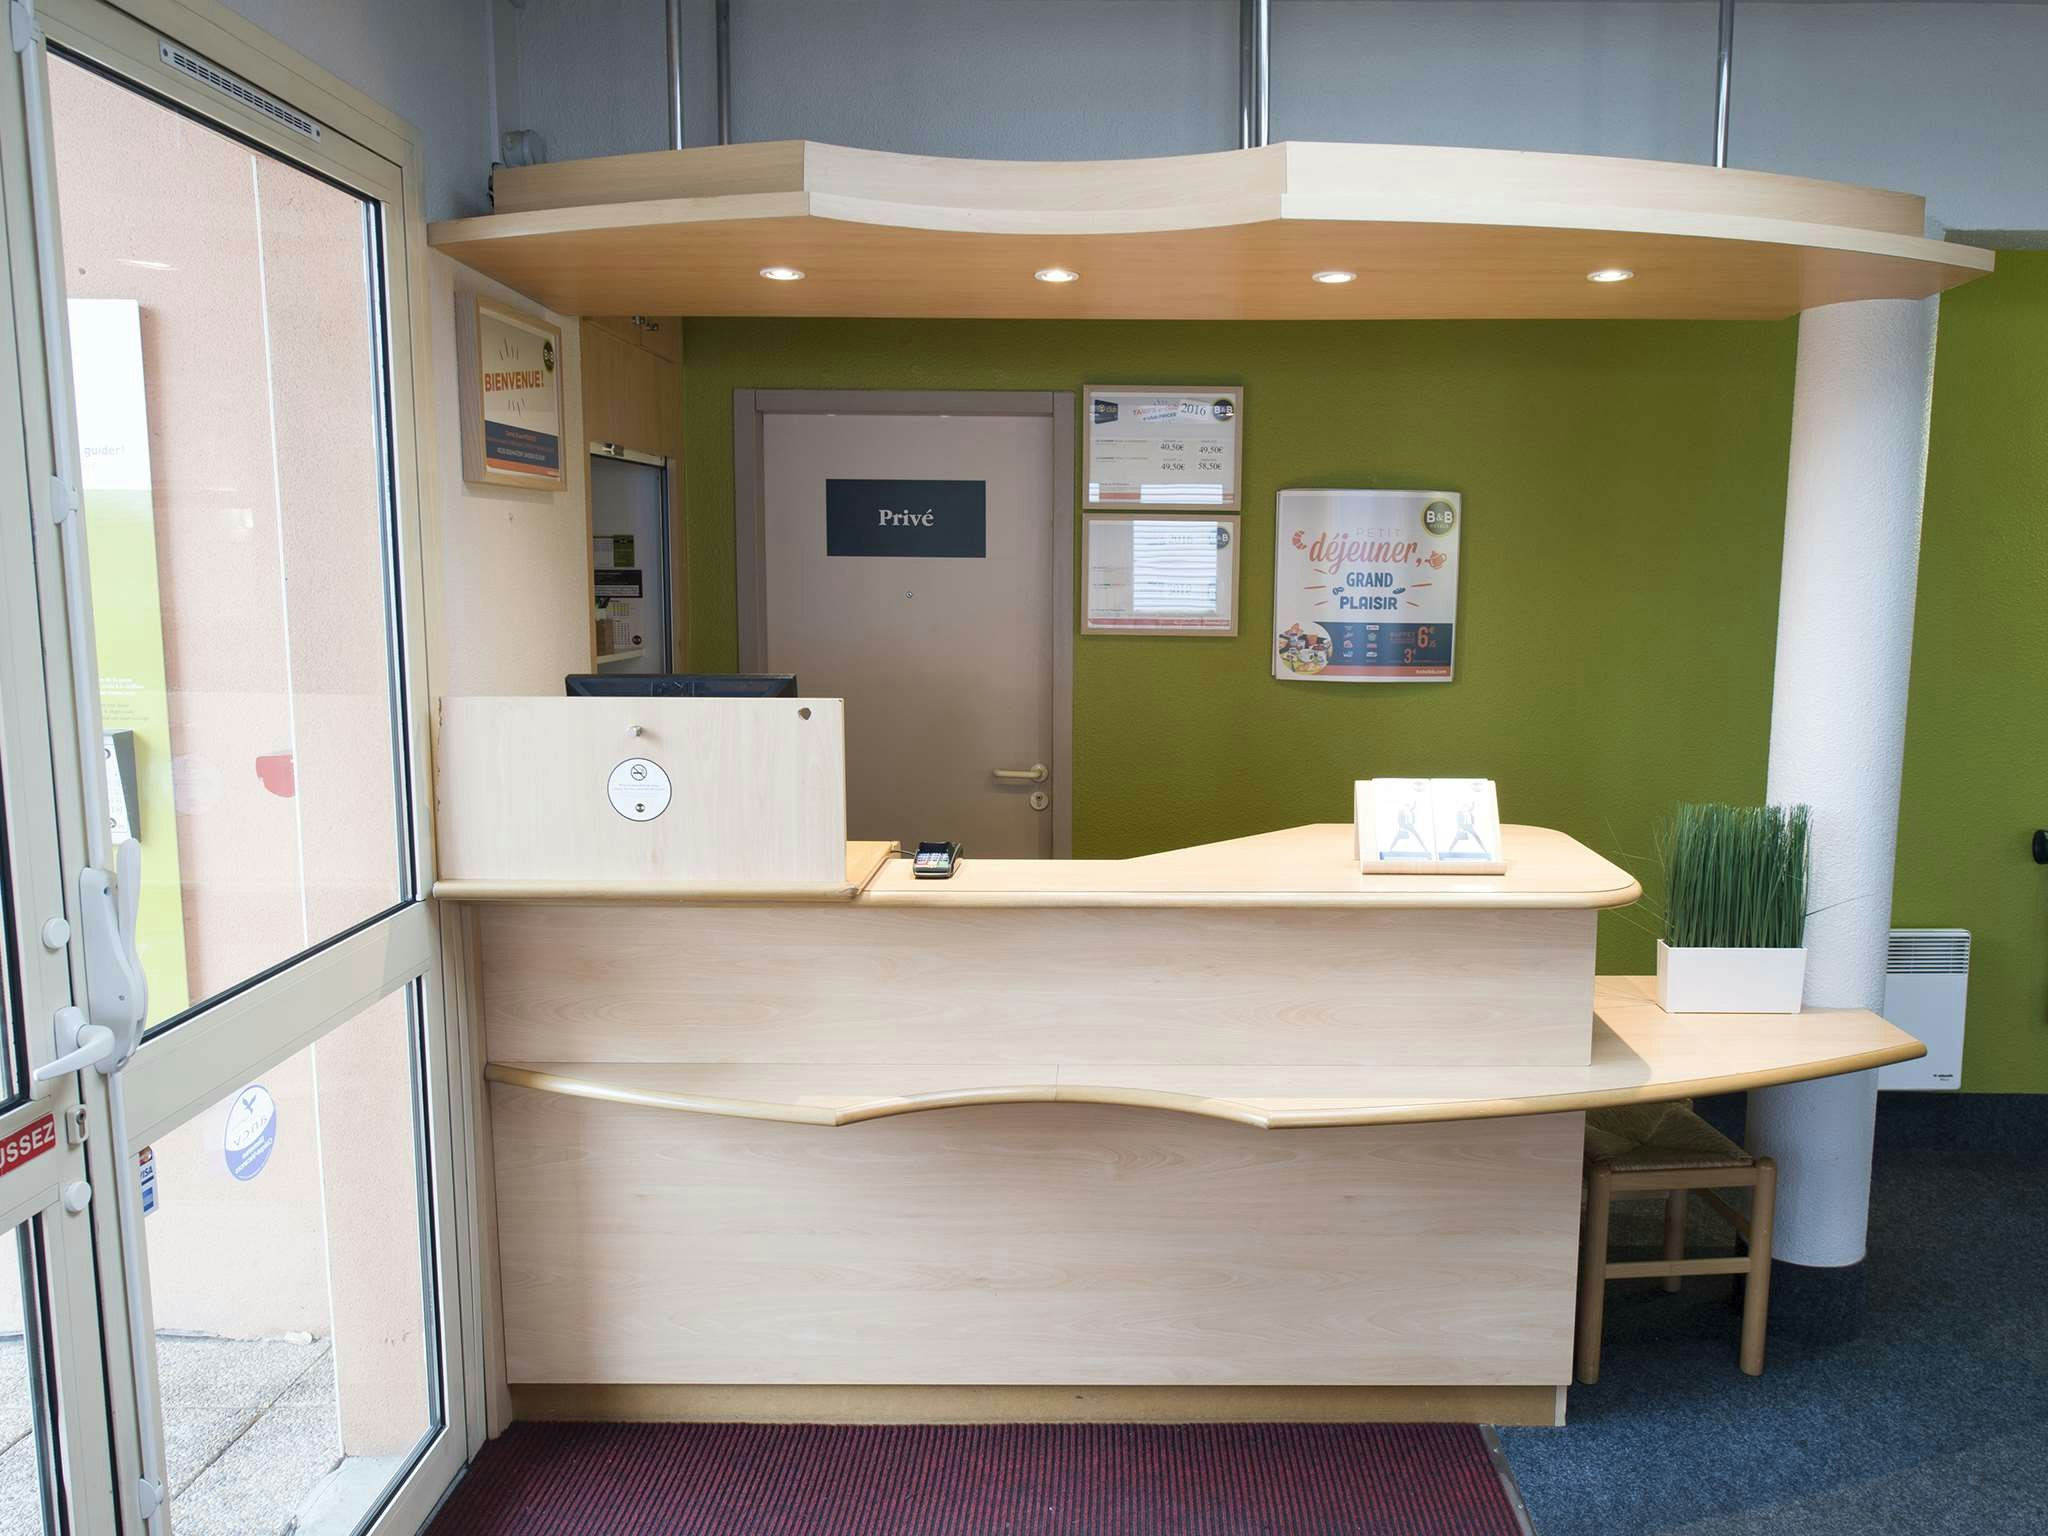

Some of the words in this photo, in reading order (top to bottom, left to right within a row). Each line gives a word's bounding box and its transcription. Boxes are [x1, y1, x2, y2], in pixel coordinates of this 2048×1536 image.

[484, 370, 545, 393] BIENVENUE!
[1181, 402, 1207, 416] 2016
[878, 508, 935, 527] Privé
[1426, 510, 1453, 524] B&B
[1346, 572, 1394, 588] GRAND
[1339, 596, 1398, 610] PLAISIR
